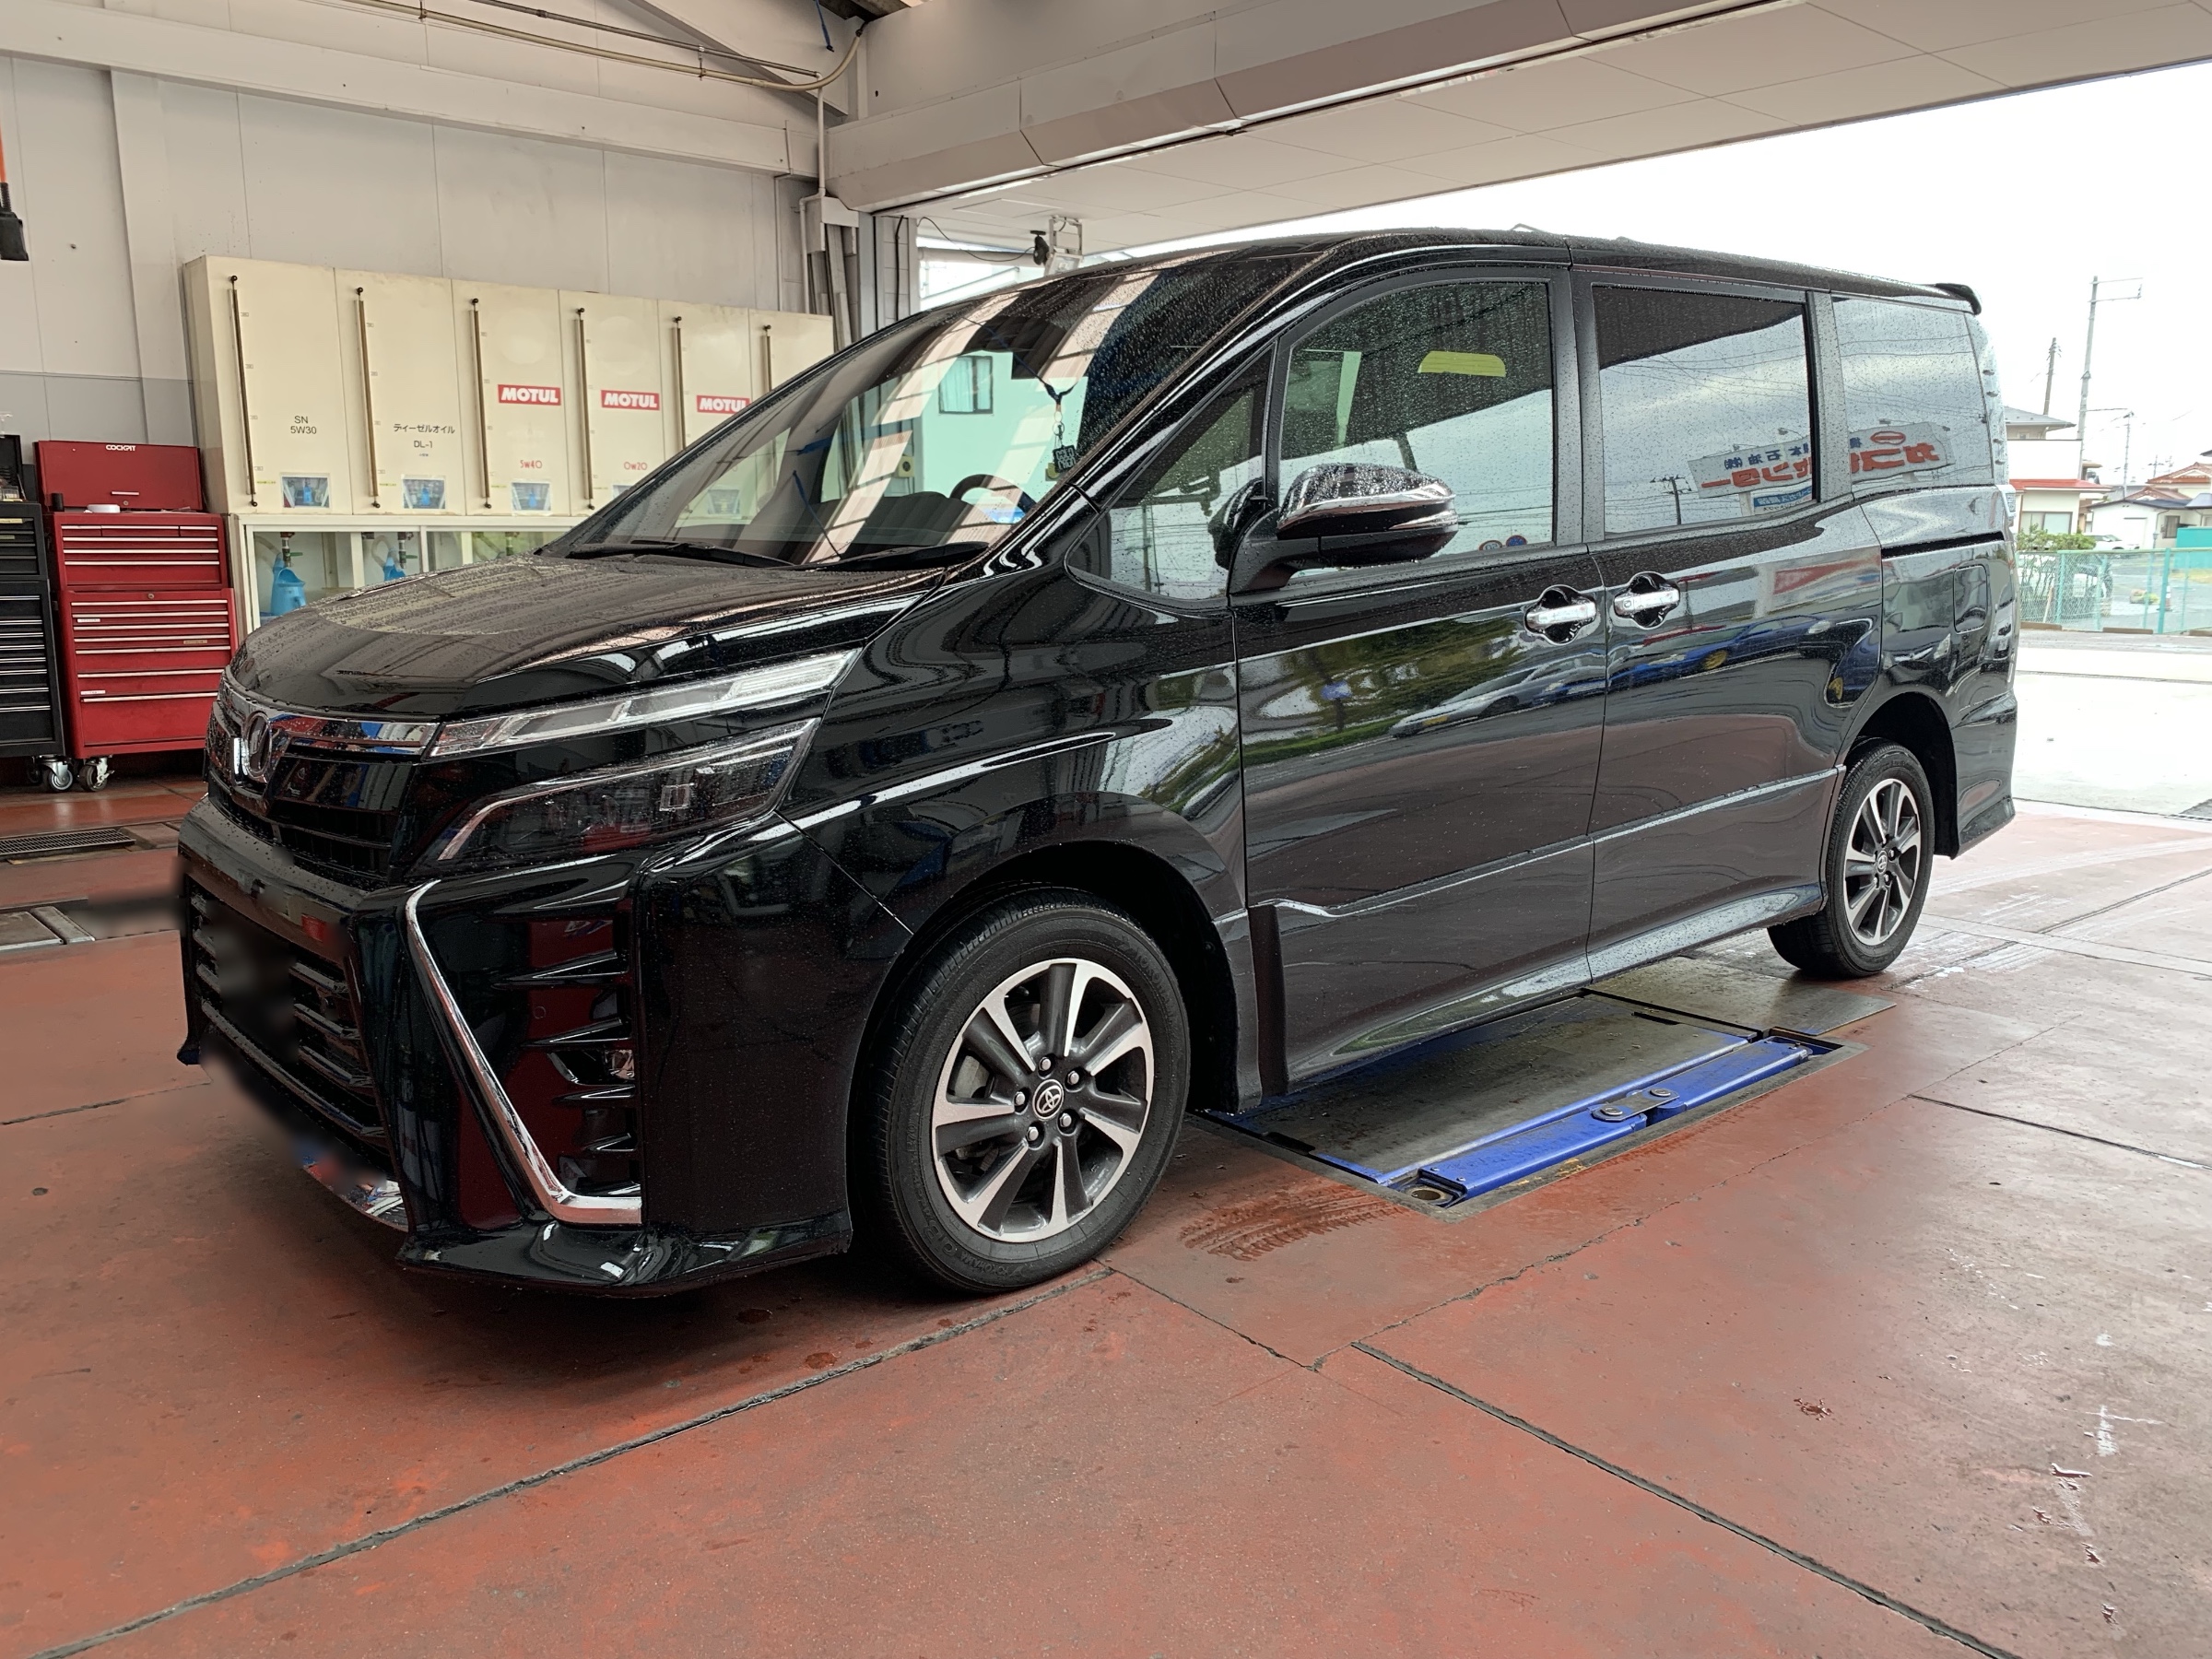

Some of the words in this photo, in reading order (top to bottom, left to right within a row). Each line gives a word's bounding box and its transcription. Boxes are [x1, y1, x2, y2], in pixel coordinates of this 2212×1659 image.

[500, 387, 559, 404] MOTUL
[604, 392, 658, 408] MOTUL
[294, 415, 309, 424] SN
[290, 425, 317, 435] 5W30
[413, 440, 433, 449] DL-1
